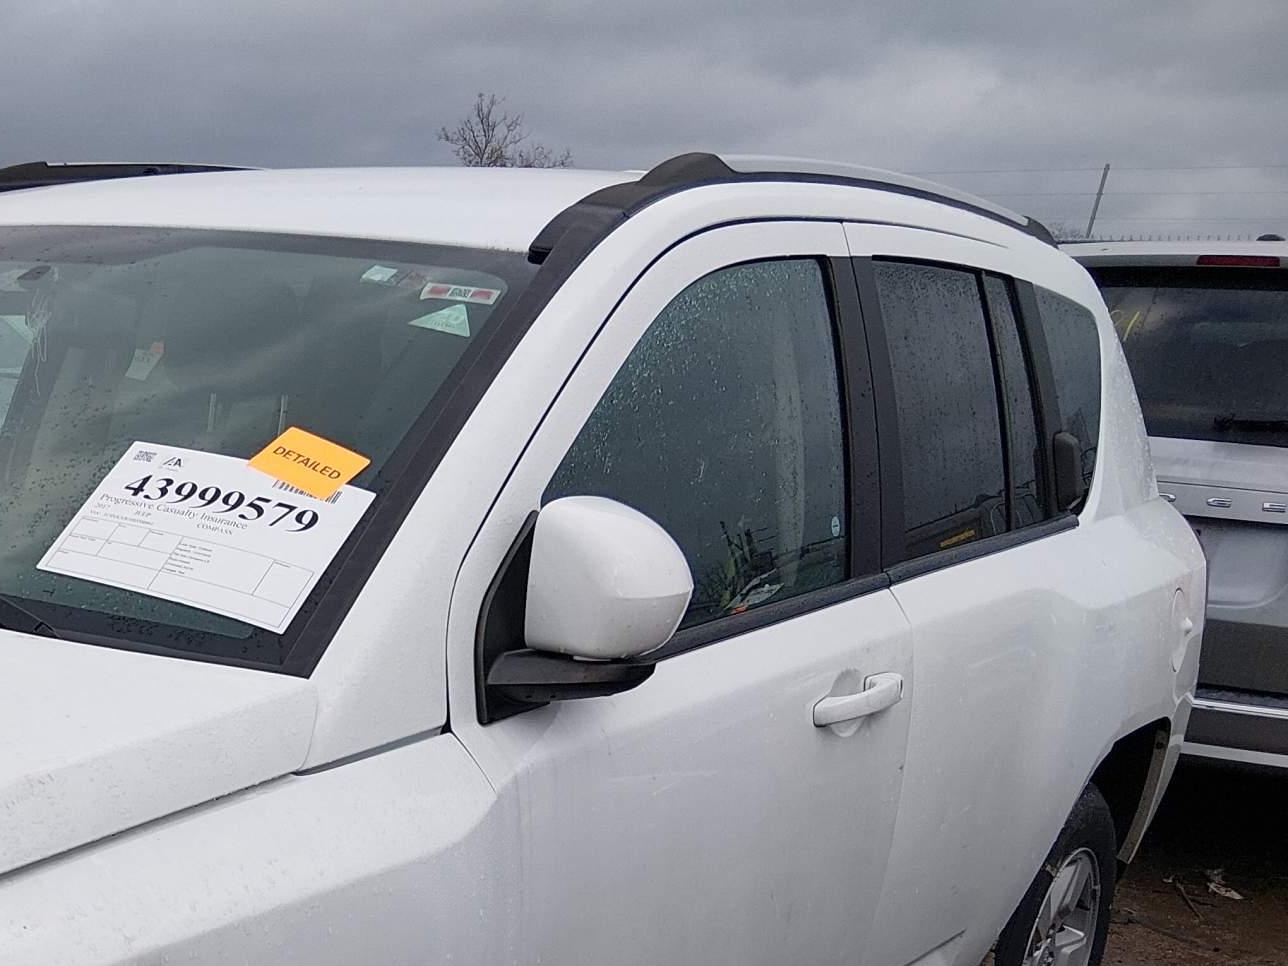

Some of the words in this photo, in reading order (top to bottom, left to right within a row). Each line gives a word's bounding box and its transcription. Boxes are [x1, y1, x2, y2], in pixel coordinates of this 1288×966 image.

[272, 445, 341, 481] DETAILED
[99, 493, 154, 510] Progressive
[156, 502, 199, 520] Casualty
[200, 512, 249, 530] Insurance
[124, 474, 320, 533] 43999579
